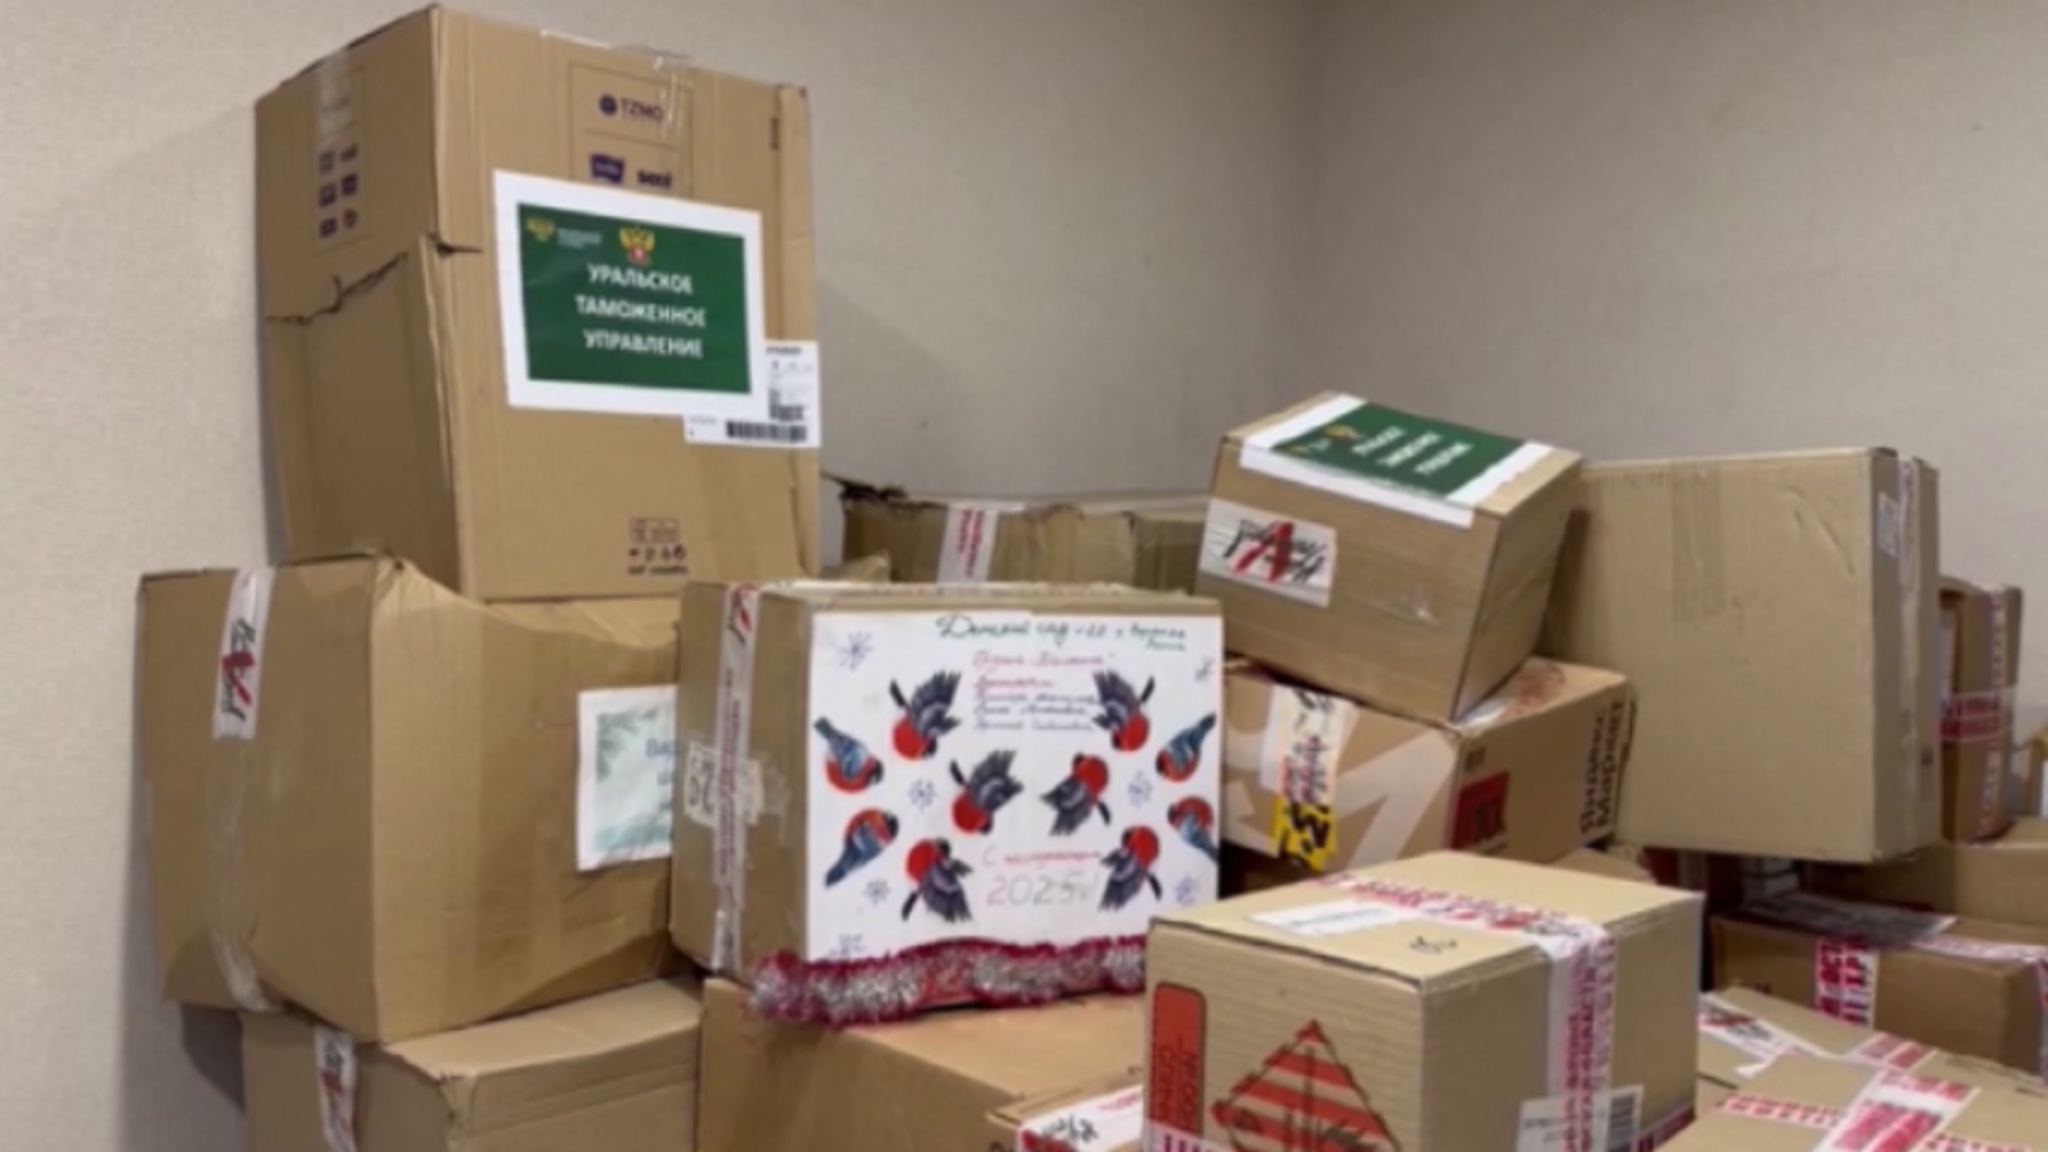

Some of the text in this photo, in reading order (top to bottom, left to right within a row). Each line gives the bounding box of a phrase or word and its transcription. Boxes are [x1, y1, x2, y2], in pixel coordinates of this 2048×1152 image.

[620, 98, 664, 121] TZMO
[588, 264, 692, 293] УРАЛЬСКОЕ
[575, 296, 705, 326] ТАМОЖЕННОЕ
[584, 330, 702, 358] УПРАВЛЕНИЕ
